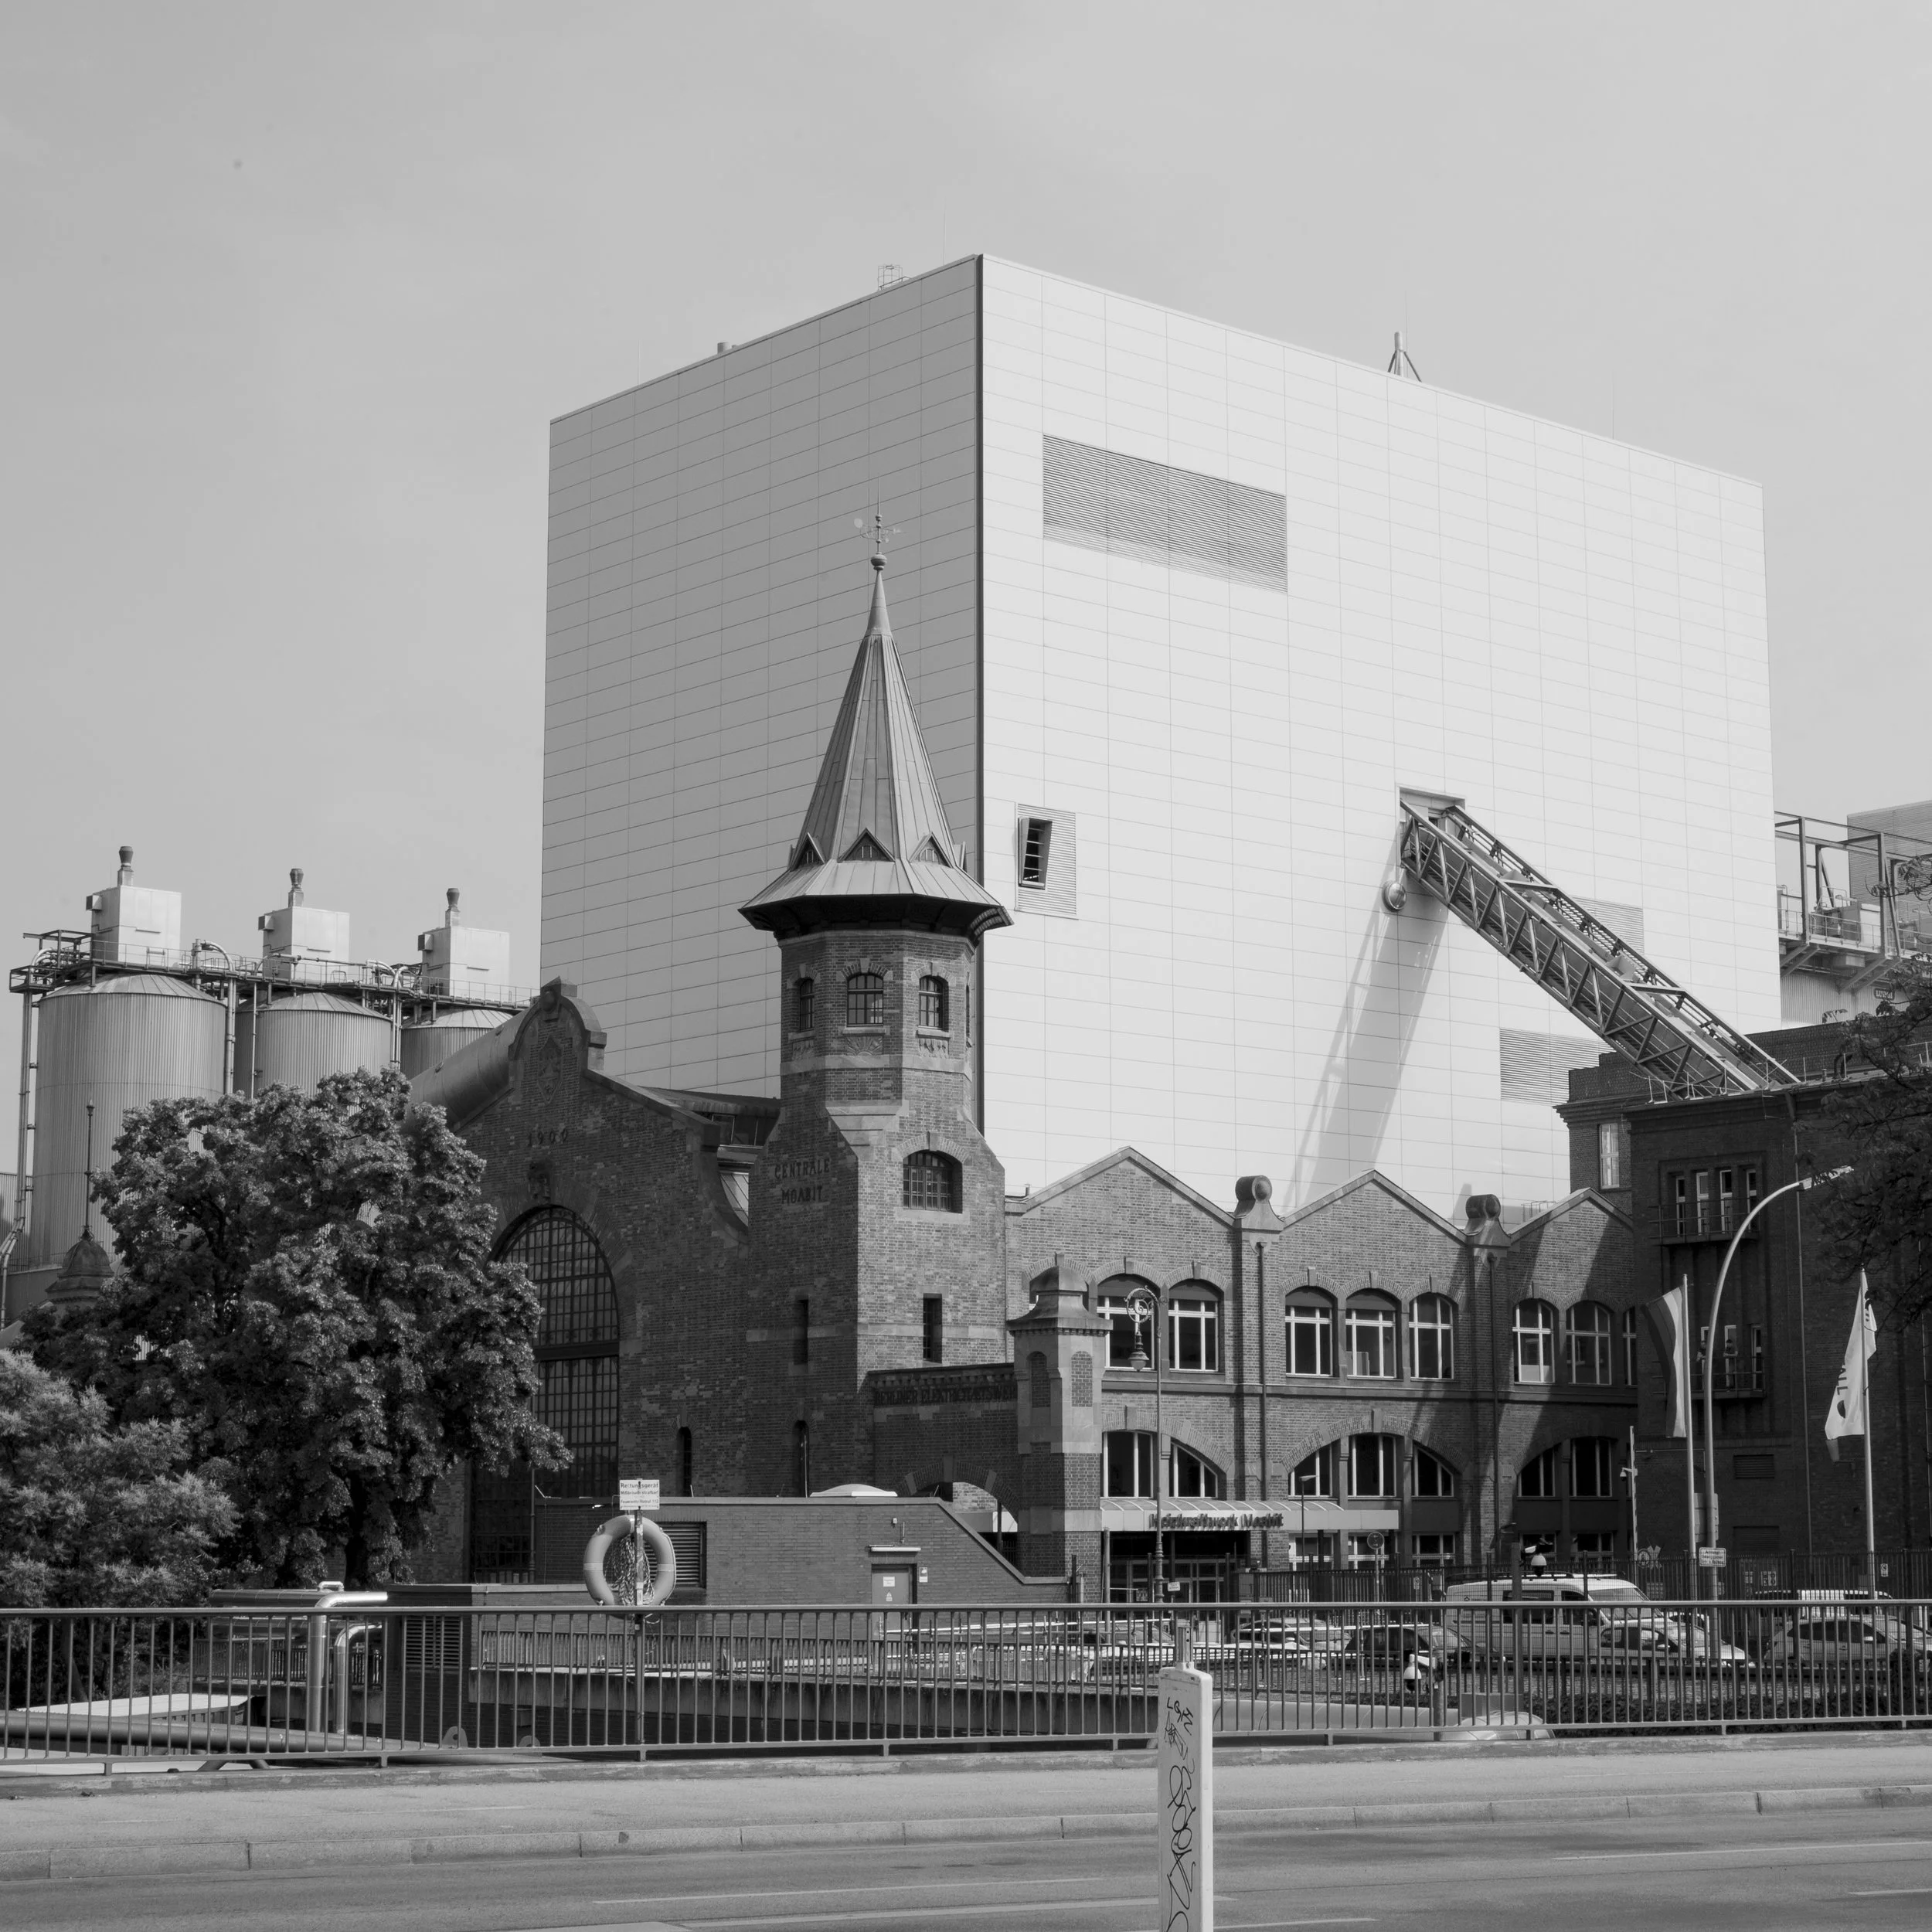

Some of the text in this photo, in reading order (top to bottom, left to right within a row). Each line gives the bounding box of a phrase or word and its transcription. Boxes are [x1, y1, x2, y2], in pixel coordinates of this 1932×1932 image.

[528, 1128, 568, 1147] 1900
[775, 1158, 830, 1179] CENTRALE
[781, 1185, 823, 1206] MOABIT
[1149, 1513, 1284, 1529] Heizkraftwerk Moabit
